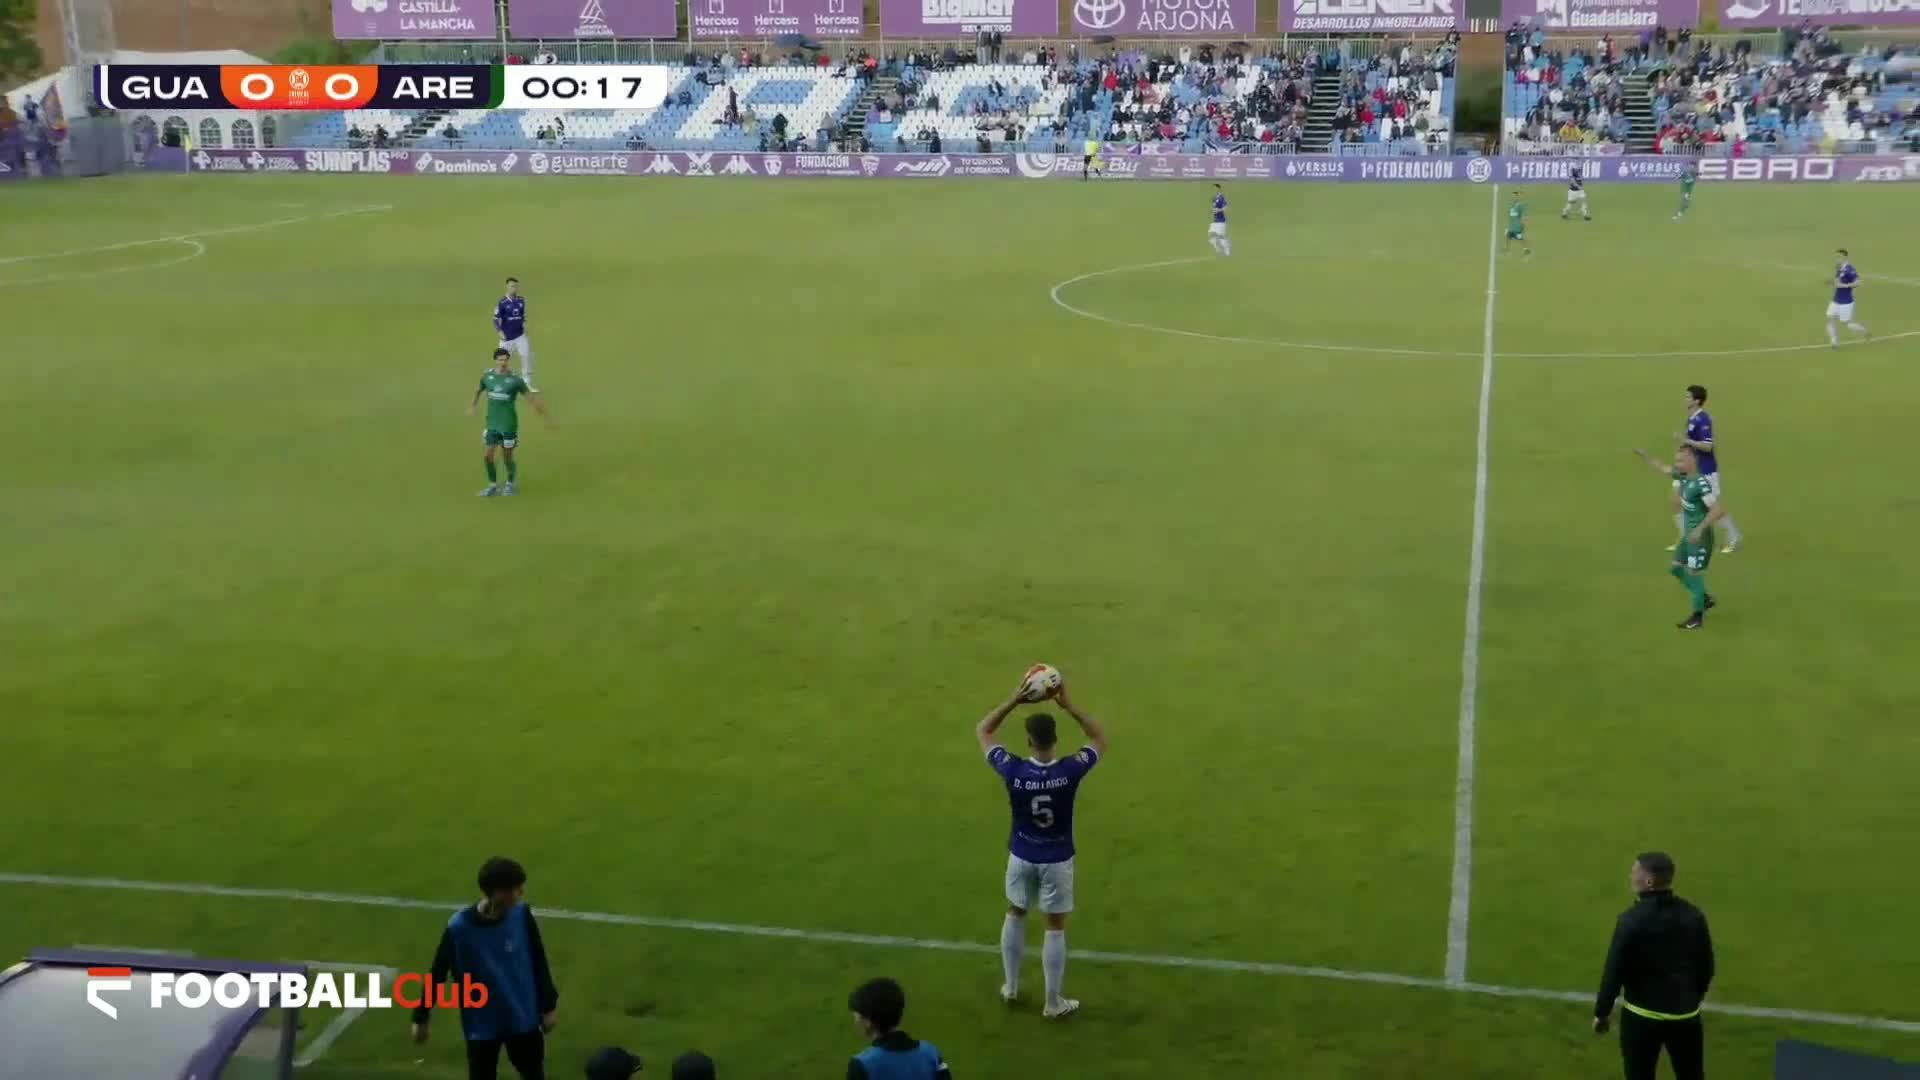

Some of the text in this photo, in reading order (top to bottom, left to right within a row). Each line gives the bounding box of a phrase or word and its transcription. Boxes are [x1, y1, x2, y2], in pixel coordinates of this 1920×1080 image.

[399, 1, 460, 14] CASTILLA-
[400, 18, 474, 30] LA MANCHA
[1137, 11, 1234, 31] ARJONA
[1292, 17, 1455, 29] DESARROLLOS INMOBILIARIOS
[1570, 9, 1658, 27] Guadalajara
[434, 160, 498, 173] Domino's
[551, 155, 629, 173] gumarfe
[795, 154, 850, 168] FUNDACIÓN
[1297, 160, 1344, 173] VERSUS
[1630, 161, 1681, 173] VERSUS
[1375, 160, 1453, 178] FEDERACIÓN
[1025, 777, 1069, 790] GALLARDO
[1031, 795, 1055, 829] 5
